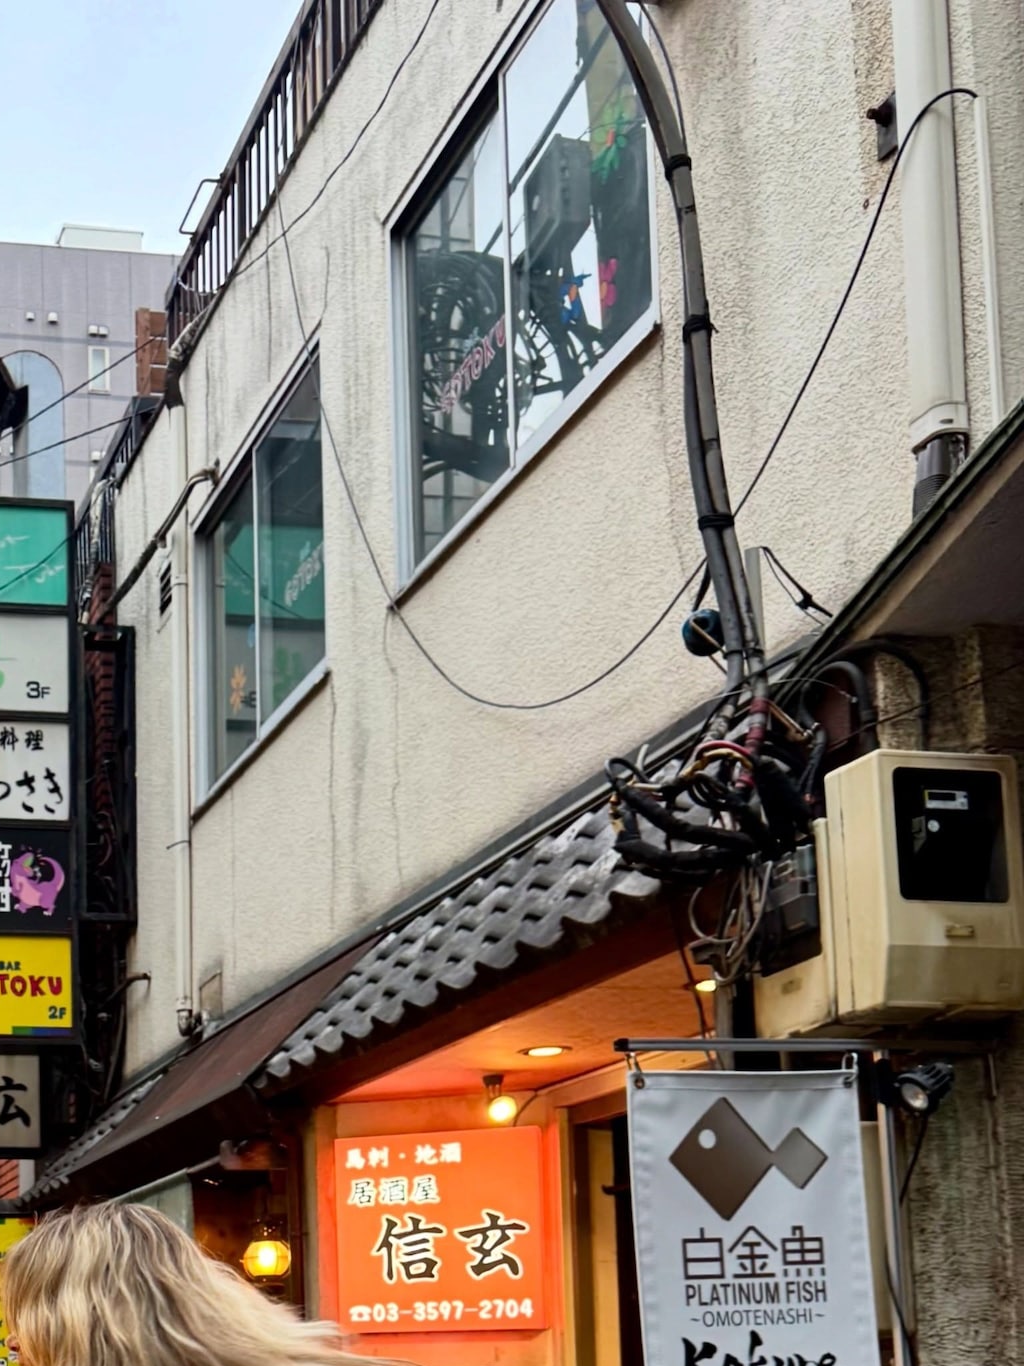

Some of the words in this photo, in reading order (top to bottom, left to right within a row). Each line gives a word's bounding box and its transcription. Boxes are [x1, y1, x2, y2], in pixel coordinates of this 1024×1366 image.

[26, 681, 50, 699] 3F
[49, 1006, 67, 1019] 2F
[348, 1174, 441, 1206] 居酒屋
[372, 1209, 529, 1284] 信玄
[685, 1283, 778, 1307] PLATINUM
[786, 1280, 827, 1303] FISH
